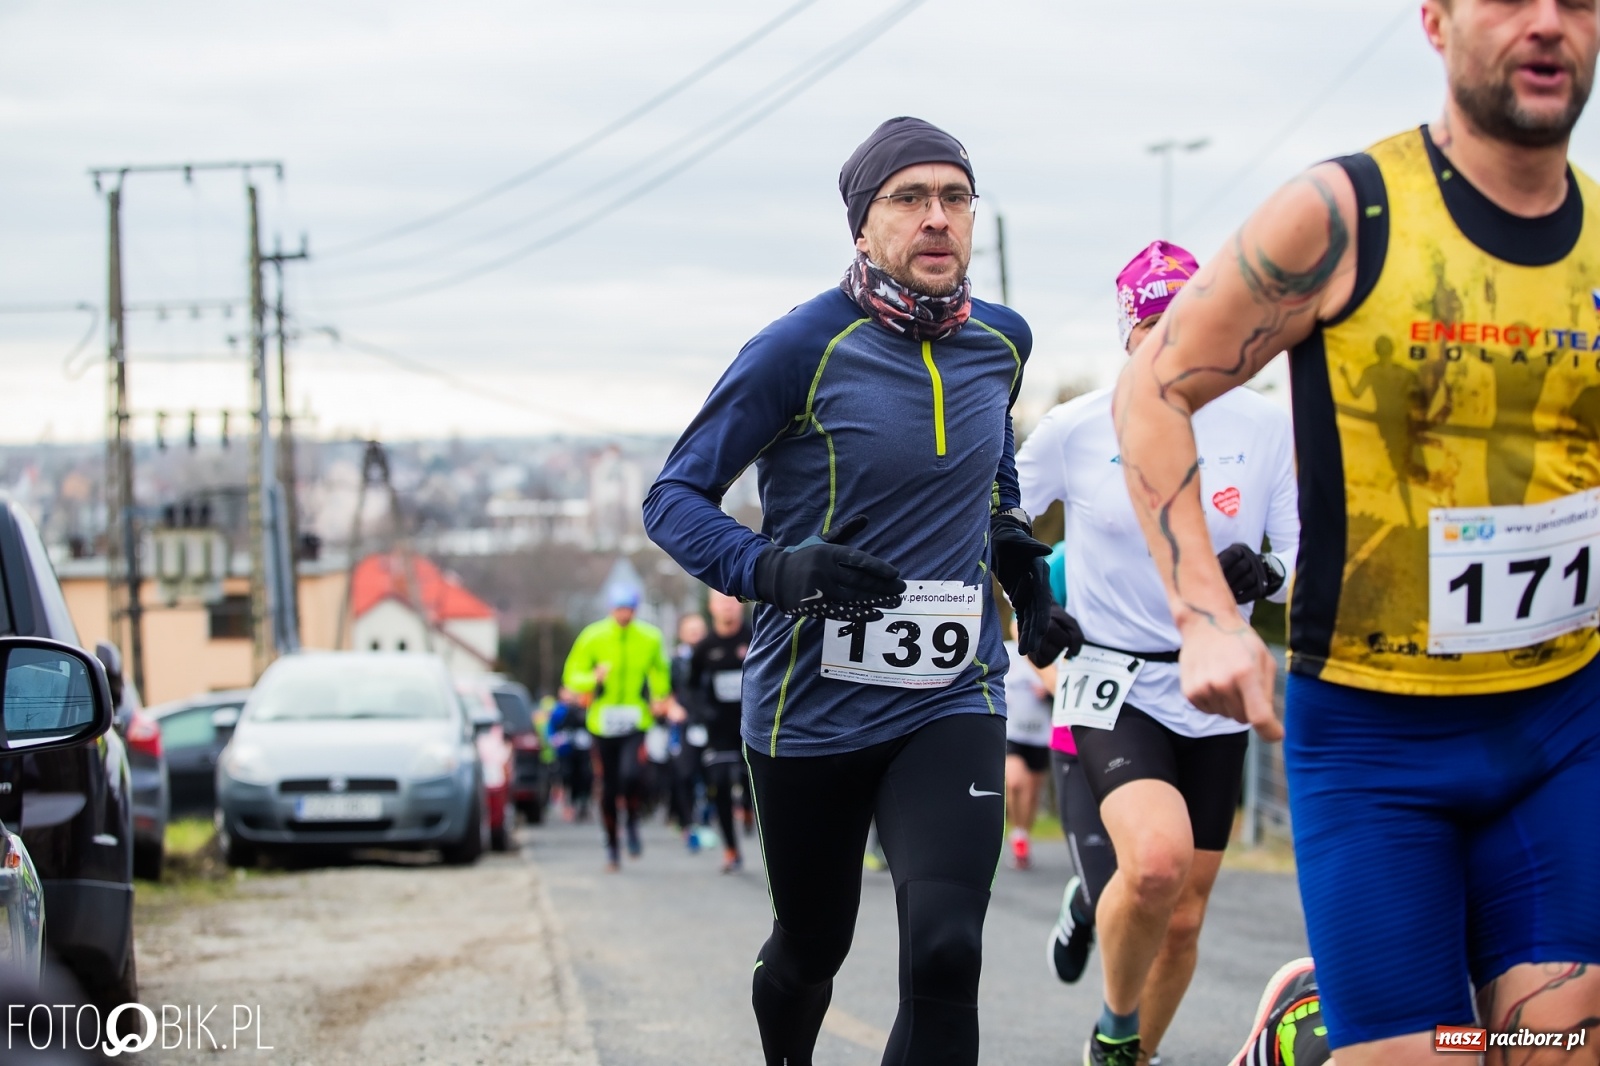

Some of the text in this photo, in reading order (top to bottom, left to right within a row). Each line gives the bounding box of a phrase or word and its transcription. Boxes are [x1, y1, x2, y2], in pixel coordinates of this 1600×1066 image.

[1136, 279, 1168, 304] XIII
[1410, 320, 1541, 347] ENERGY
[1409, 345, 1600, 373] BOLATI
[900, 593, 976, 604] w.personalbest.pl
[1448, 545, 1590, 625] 171
[837, 619, 970, 669] 139
[1061, 674, 1120, 711] 119
